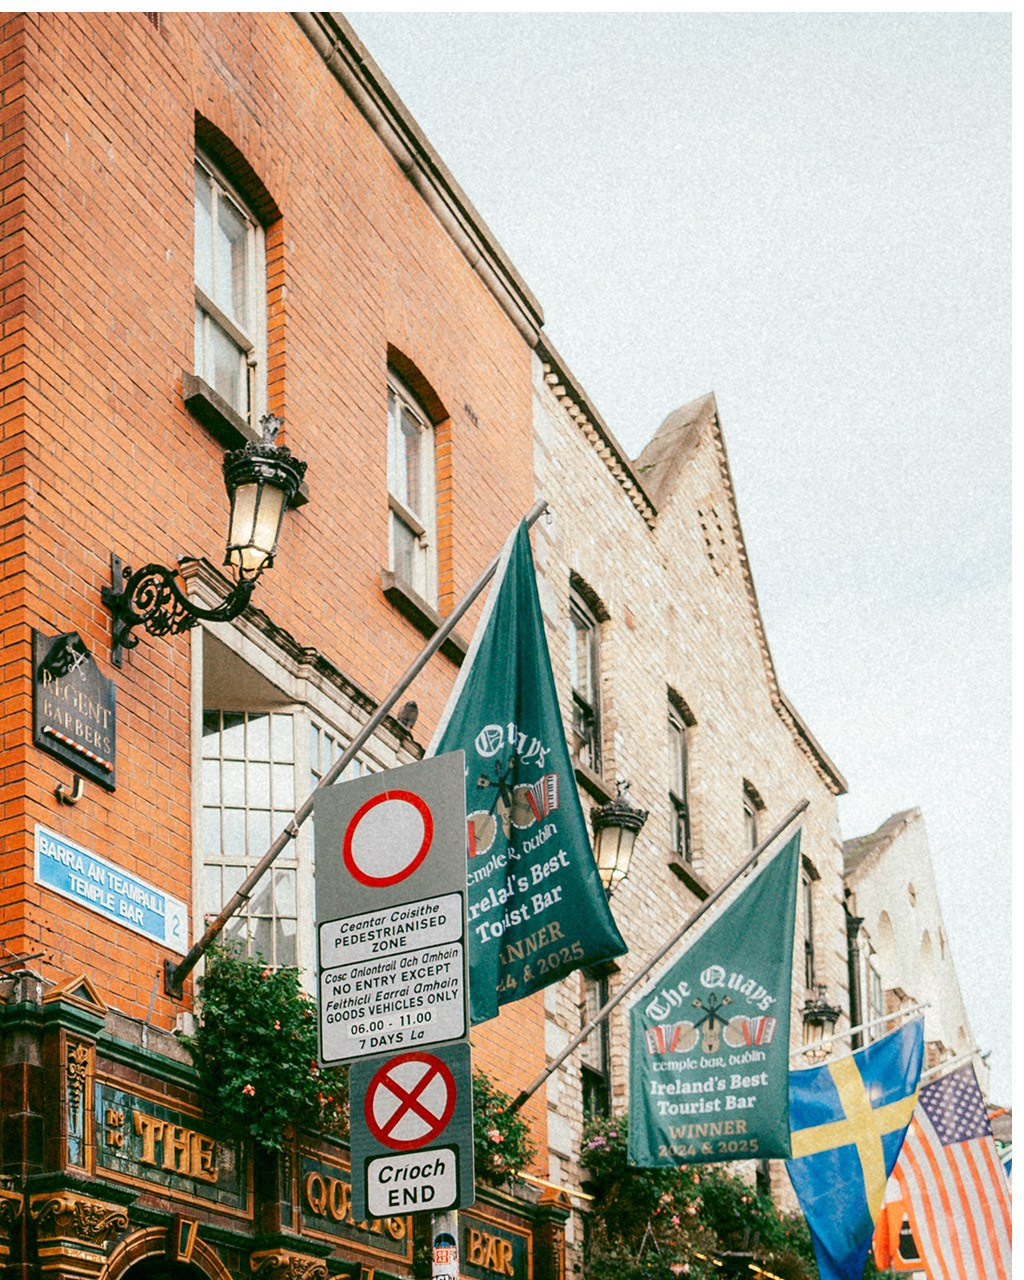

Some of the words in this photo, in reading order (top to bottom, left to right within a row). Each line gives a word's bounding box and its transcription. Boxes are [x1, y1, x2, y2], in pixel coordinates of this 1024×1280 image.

[43, 669, 112, 729] REGENT
[44, 699, 111, 754] BARBERS
[39, 837, 84, 875] BARRA
[87, 862, 105, 885] AN
[107, 872, 165, 917] TEAMPAILL
[530, 849, 570, 885] Best
[68, 873, 115, 912] TEMPLE
[119, 899, 144, 926] BAR
[530, 885, 562, 915] Bar
[172, 915, 180, 937] 2
[334, 915, 447, 948] PEDESTRIANISED
[340, 916, 386, 934] Ceantar
[390, 904, 440, 922] Coisithe
[372, 936, 407, 953] ZONE
[523, 964, 535, 983] &
[537, 940, 585, 975] 2025
[325, 972, 347, 984] Cosc
[332, 983, 351, 996] NO
[356, 974, 396, 991] ENTRY
[402, 962, 451, 982] EXCEPT
[645, 980, 692, 1021] The
[699, 964, 777, 1012] Quays
[326, 1007, 365, 1024] GOODS
[368, 996, 424, 1016] VEHICLES
[427, 989, 459, 1004] ONLY
[351, 1020, 384, 1035] 06.00
[400, 1011, 432, 1027] 11.00
[359, 1039, 366, 1050] 7
[370, 1032, 403, 1047] DAYS
[411, 1030, 424, 1041] La
[650, 1076, 727, 1096] Ireland's
[729, 1071, 769, 1090] Best
[657, 1097, 722, 1116] Tourist
[725, 1095, 757, 1110] Bar
[107, 1129, 125, 1148] 10
[668, 1119, 748, 1140] WINNER
[133, 1110, 219, 1183] THE
[658, 1144, 697, 1157] 2024
[701, 1141, 714, 1155] &
[718, 1139, 759, 1153] 2025
[378, 1157, 446, 1184] Críoch
[388, 1185, 435, 1207] END
[466, 1227, 515, 1277] BAR
